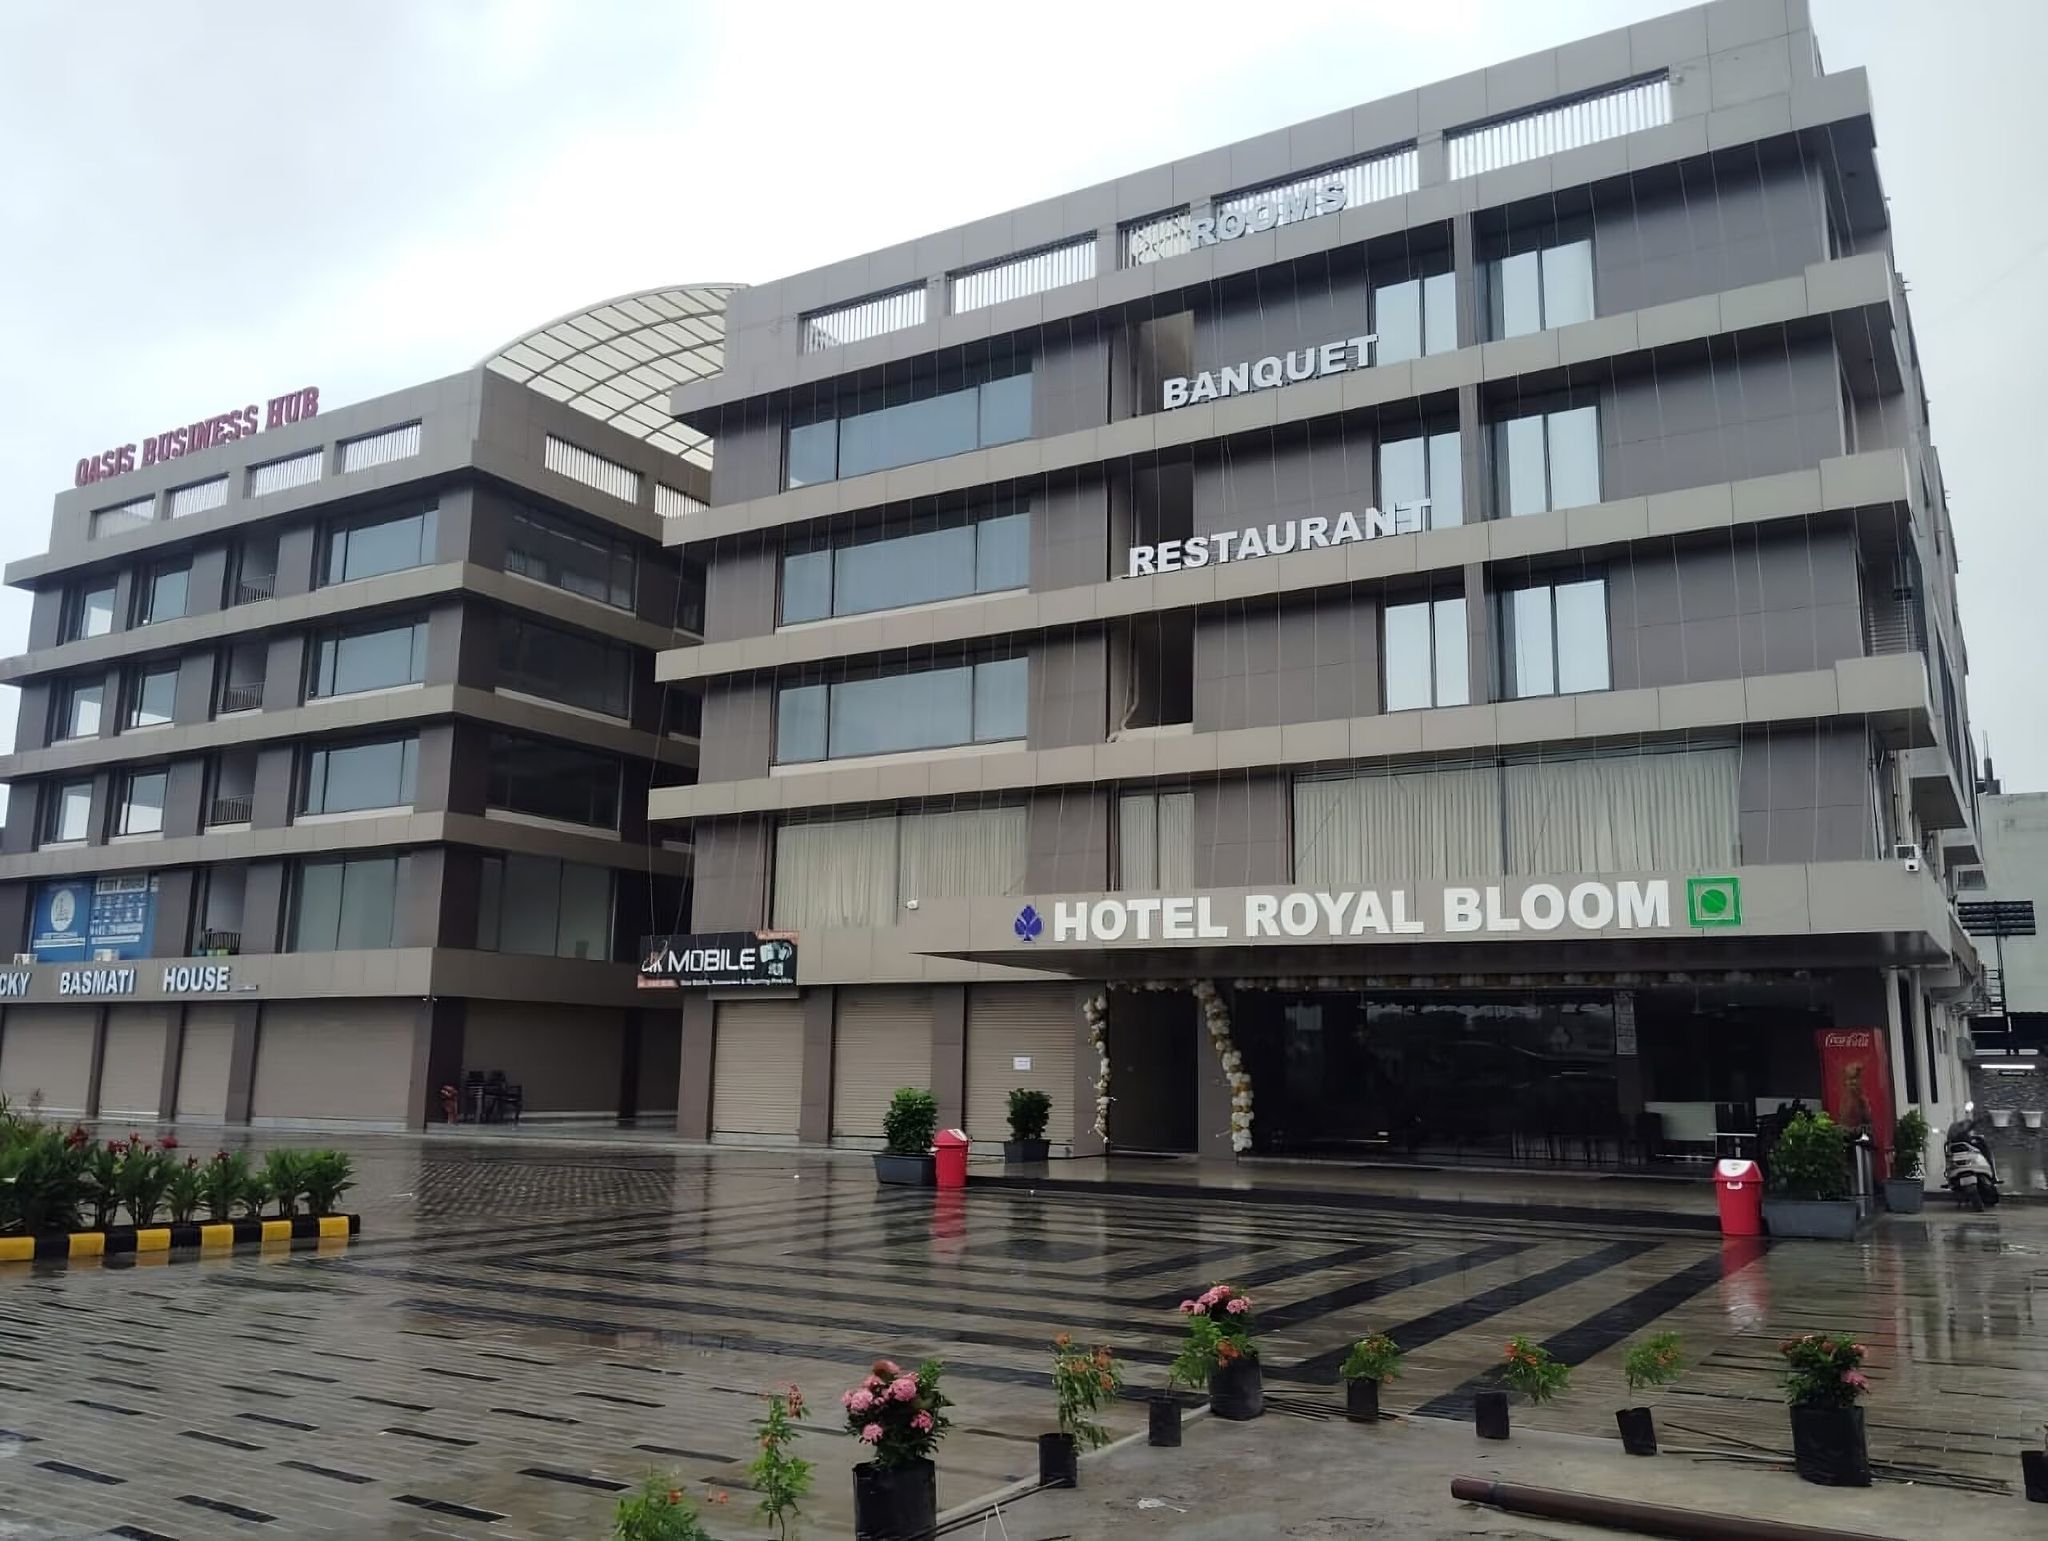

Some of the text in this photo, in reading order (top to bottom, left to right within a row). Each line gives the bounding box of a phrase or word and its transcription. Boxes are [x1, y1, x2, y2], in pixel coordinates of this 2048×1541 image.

[1192, 183, 1346, 248] ROOMS
[1163, 334, 1377, 410] BANQUET
[75, 386, 319, 487] OASIS BUSINESS HUB
[1128, 499, 1431, 578] RESTAURANT
[1053, 880, 1670, 943] HOTEL ROYAL BLOOM
[60, 968, 136, 996] BASMATI
[162, 966, 230, 993] HOUSE
[668, 948, 756, 973] MOBILE
